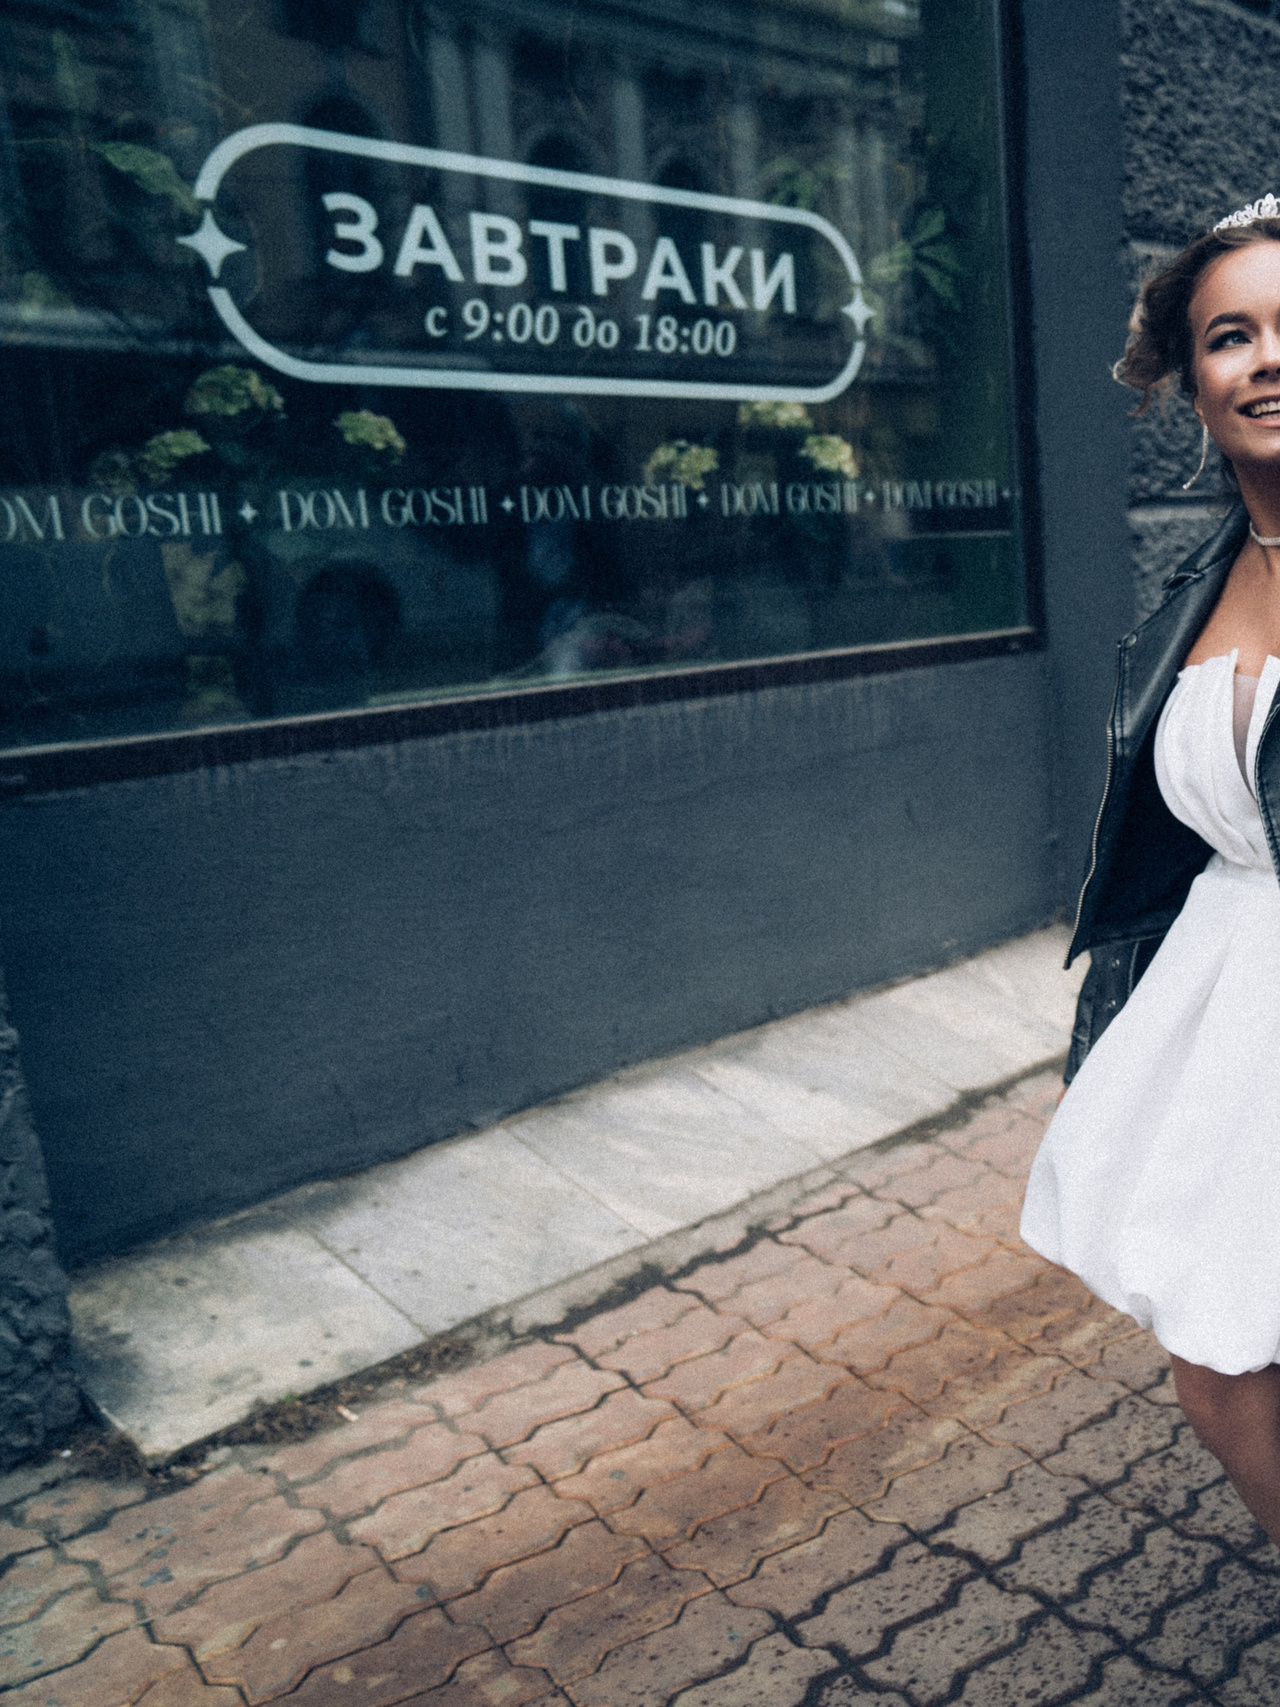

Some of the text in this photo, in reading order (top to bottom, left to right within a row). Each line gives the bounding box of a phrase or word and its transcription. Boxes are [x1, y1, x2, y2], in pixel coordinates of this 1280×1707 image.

[323, 192, 796, 314] ЗАВТРАКИ
[425, 298, 737, 357] с 9:00 до 18:00
[81, 492, 223, 538] GOSHI
[279, 488, 368, 531] DOM
[381, 486, 488, 527] GOSHI
[521, 485, 591, 523] DOM
[600, 483, 686, 519] GOSHI
[720, 482, 779, 516] DOM
[786, 481, 858, 513] GOSHI
